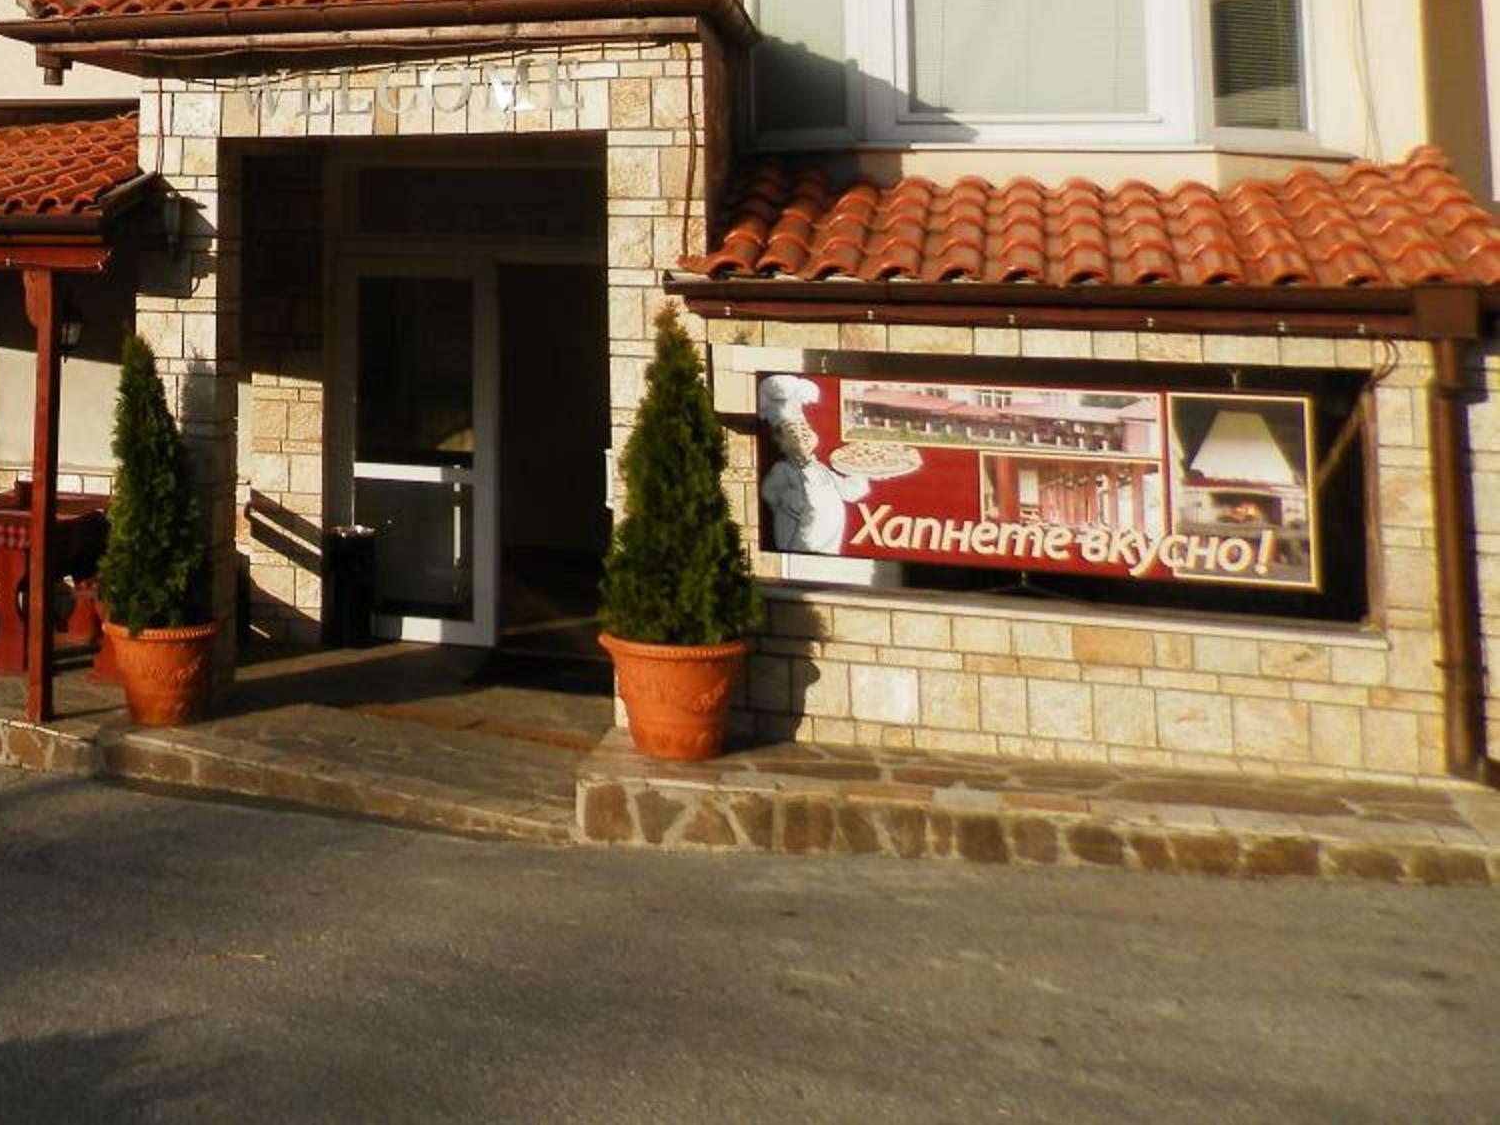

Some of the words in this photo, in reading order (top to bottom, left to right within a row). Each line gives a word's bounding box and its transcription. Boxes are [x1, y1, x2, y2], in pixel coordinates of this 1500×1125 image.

[235, 58, 586, 118] WELCOME
[850, 502, 1074, 560] Хапнете
[1078, 524, 1274, 576] вкусно!
